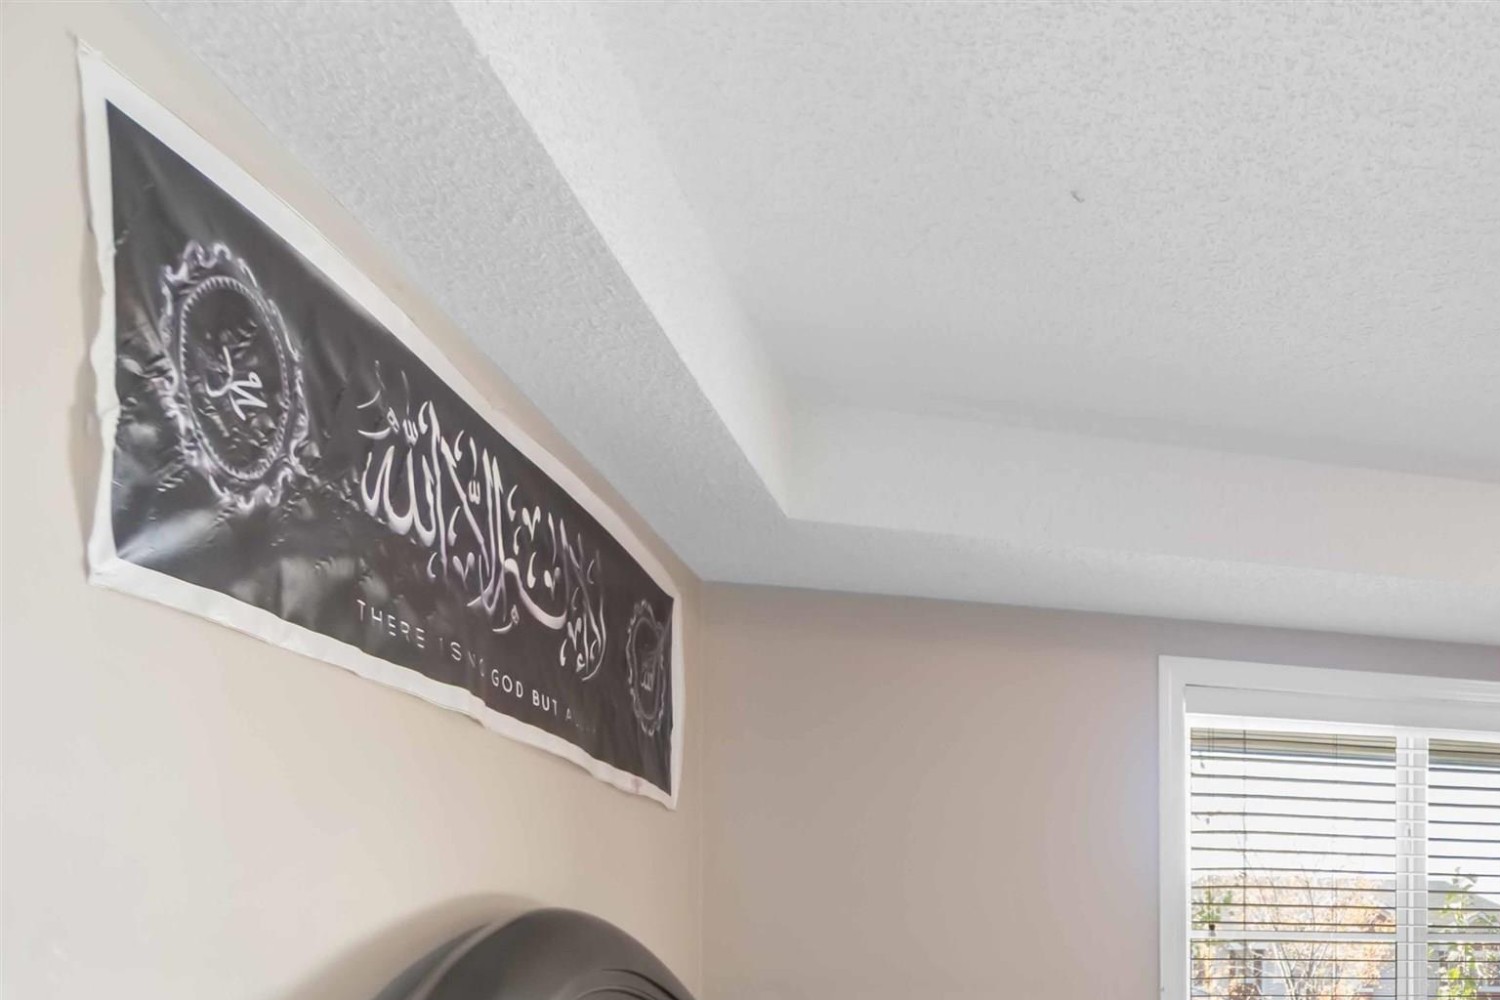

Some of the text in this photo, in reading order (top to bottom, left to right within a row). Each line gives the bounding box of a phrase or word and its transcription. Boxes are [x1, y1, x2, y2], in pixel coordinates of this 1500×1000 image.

[356, 598, 425, 649] THERE
[438, 636, 462, 661] IS
[491, 668, 524, 698] GOD
[531, 689, 558, 716] BUT
